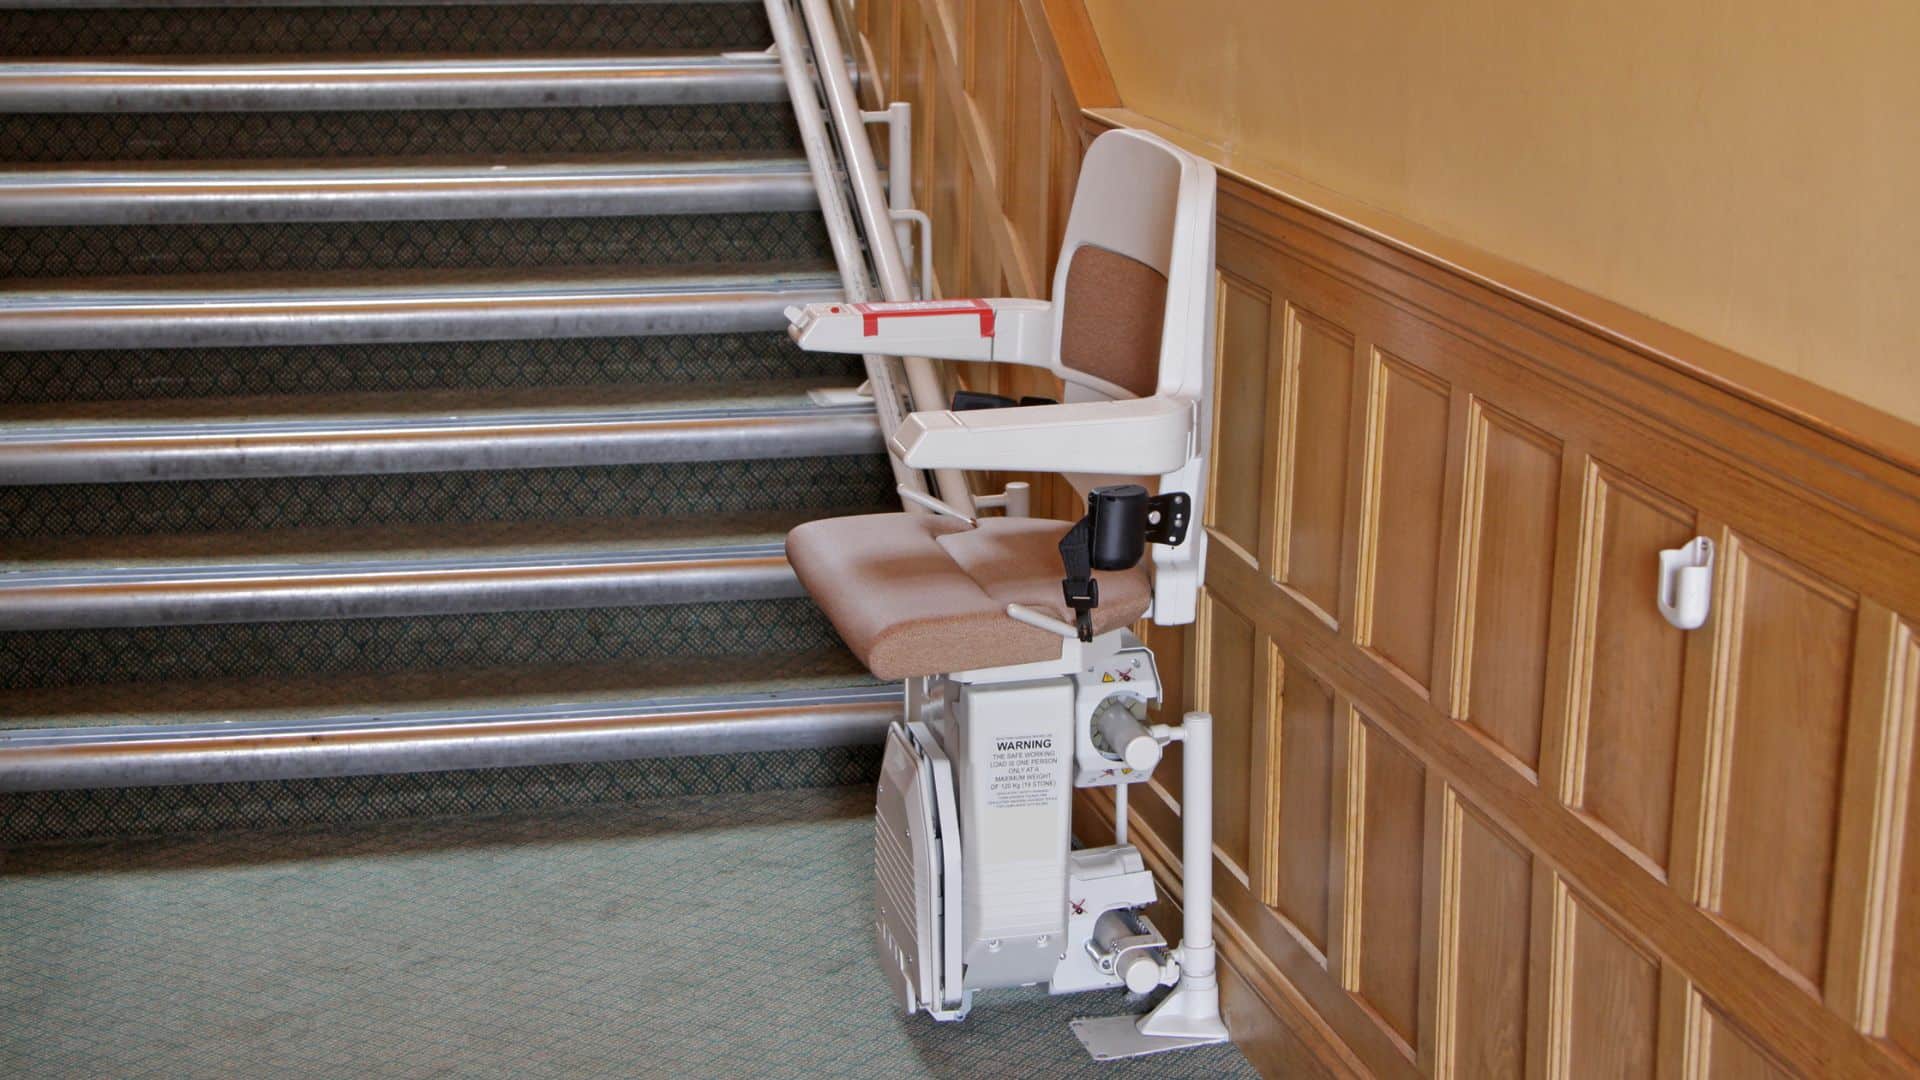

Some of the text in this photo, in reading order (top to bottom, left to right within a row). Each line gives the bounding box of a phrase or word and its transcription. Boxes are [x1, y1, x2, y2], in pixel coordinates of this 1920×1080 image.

[996, 739, 1052, 751] WARNING
[1007, 752, 1023, 760] SAFE
[1025, 750, 1056, 758] WORKING
[990, 760, 1008, 768] LOAD
